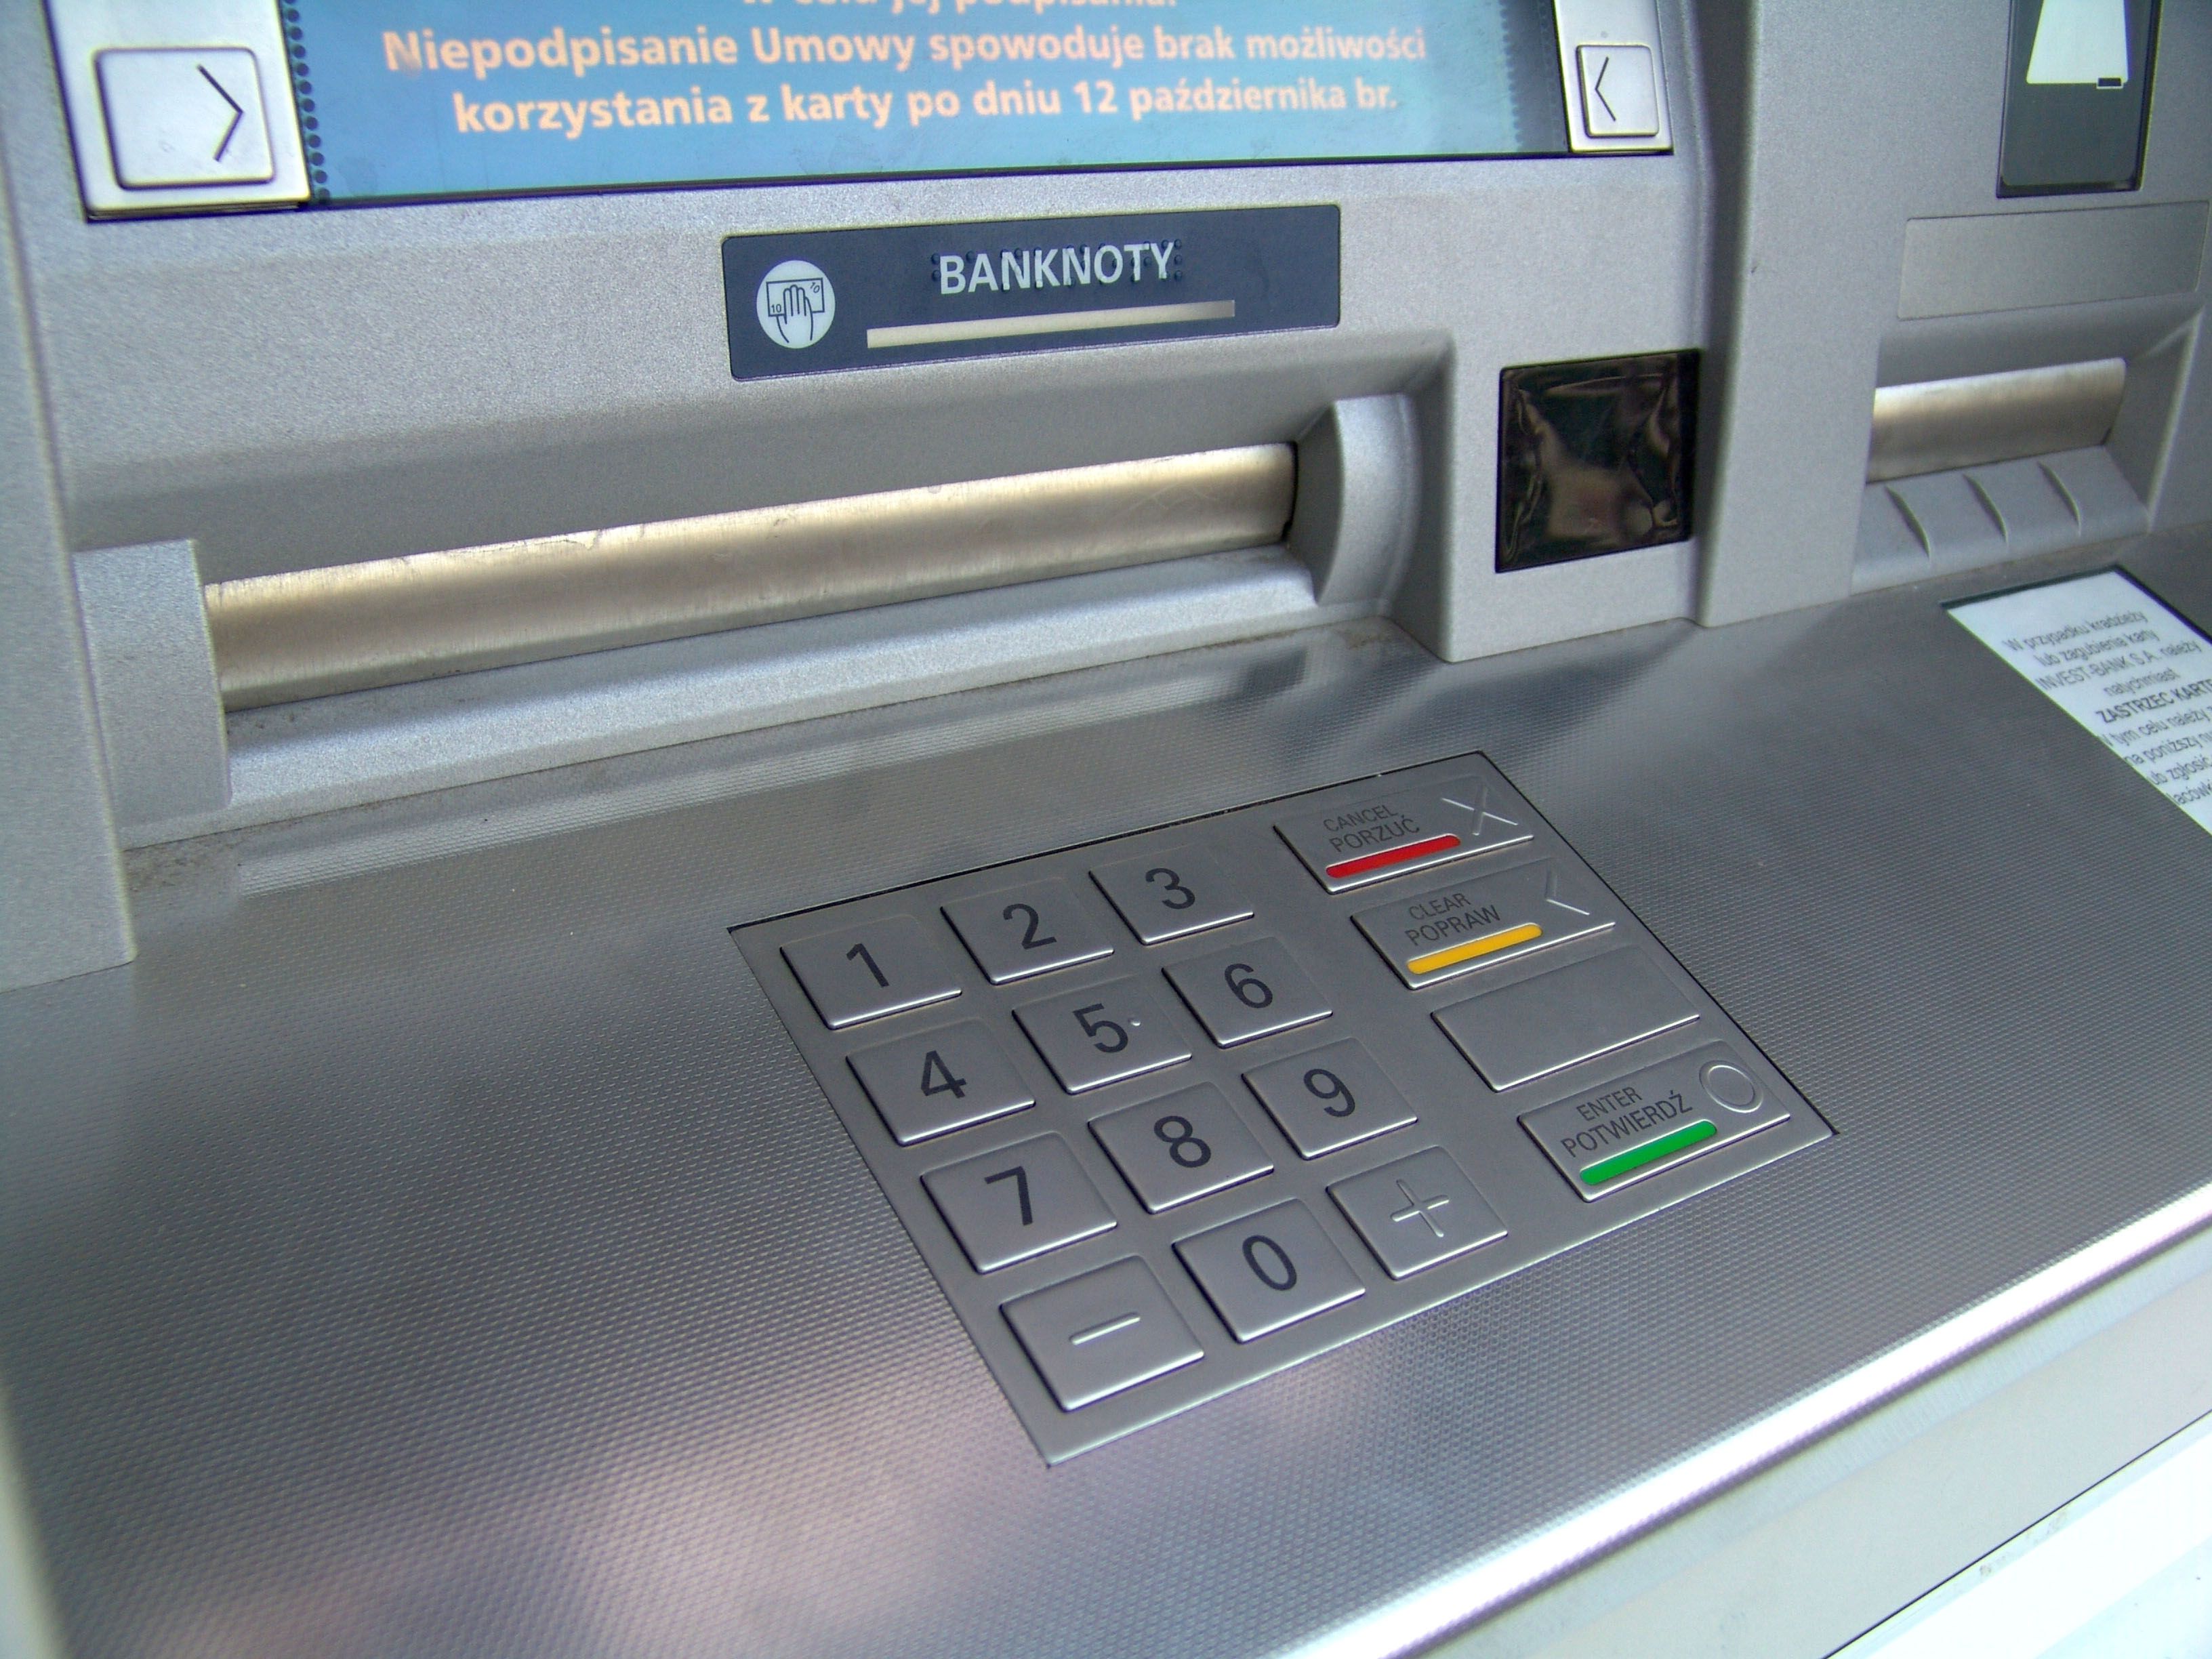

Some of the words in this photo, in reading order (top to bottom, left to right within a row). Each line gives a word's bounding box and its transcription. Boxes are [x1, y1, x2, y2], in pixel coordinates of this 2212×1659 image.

[382, 24, 738, 79] Niepodpisanie
[752, 27, 915, 71] Umowy
[928, 24, 1144, 70] spowoduje
[1154, 24, 1235, 59] brak
[1246, 25, 1425, 59] możliwości
[453, 85, 733, 139] korzystania
[747, 95, 770, 122] z
[781, 83, 892, 129] karty
[907, 90, 960, 127] po
[973, 79, 1061, 116] dniu
[1073, 79, 1118, 113] 12
[1129, 77, 1347, 121] października
[1355, 76, 1397, 109] br.
[939, 241, 1175, 295] BANKNOTY
[771, 304, 782, 313] 10
[2095, 691, 2174, 724] ZASTRZEC
[1324, 804, 1399, 832] CANCEL
[1329, 815, 1420, 853] PORZUĆ
[1145, 867, 1196, 909] 3
[1408, 893, 1471, 920] CLEAR
[1003, 903, 1057, 949] 2
[1404, 905, 1500, 947] POPRAW
[846, 943, 890, 987] 1
[1224, 963, 1273, 1008] 6
[1073, 1004, 1129, 1053] 5
[920, 1050, 967, 1099] 4
[1303, 1068, 1356, 1118] 9
[1561, 1090, 1693, 1158] POTWIERDŹ
[1576, 1086, 1642, 1122] ENTER
[1153, 1115, 1212, 1168] 8
[984, 1166, 1033, 1225] 7
[1242, 1235, 1298, 1292] 0
